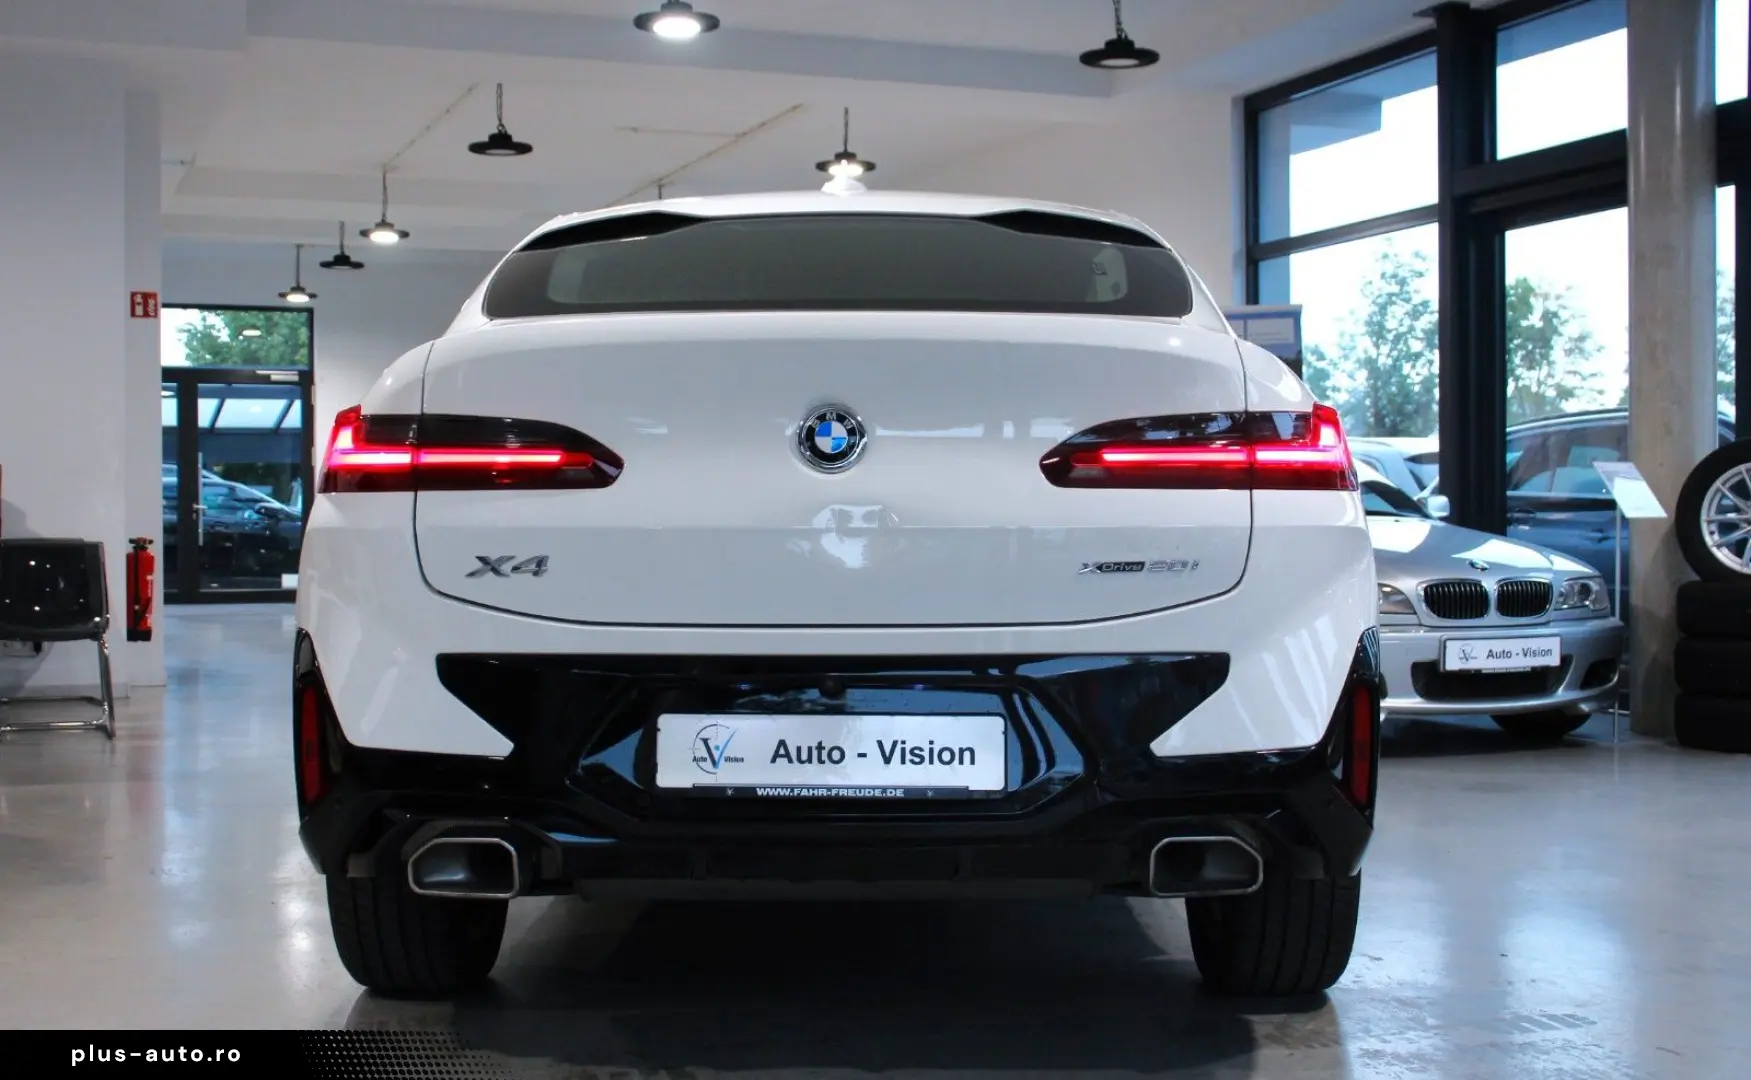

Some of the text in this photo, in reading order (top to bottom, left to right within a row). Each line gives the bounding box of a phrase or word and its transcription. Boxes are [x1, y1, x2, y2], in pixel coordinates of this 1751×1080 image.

[464, 554, 549, 578] X4
[1486, 648, 1513, 660] Auto
[1522, 647, 1553, 658] Vision
[770, 738, 846, 765] Auto
[876, 739, 976, 766] Vision
[692, 755, 744, 763] Auto Vision
[756, 787, 905, 797] WWW.FAHR-FREUDE.DE
